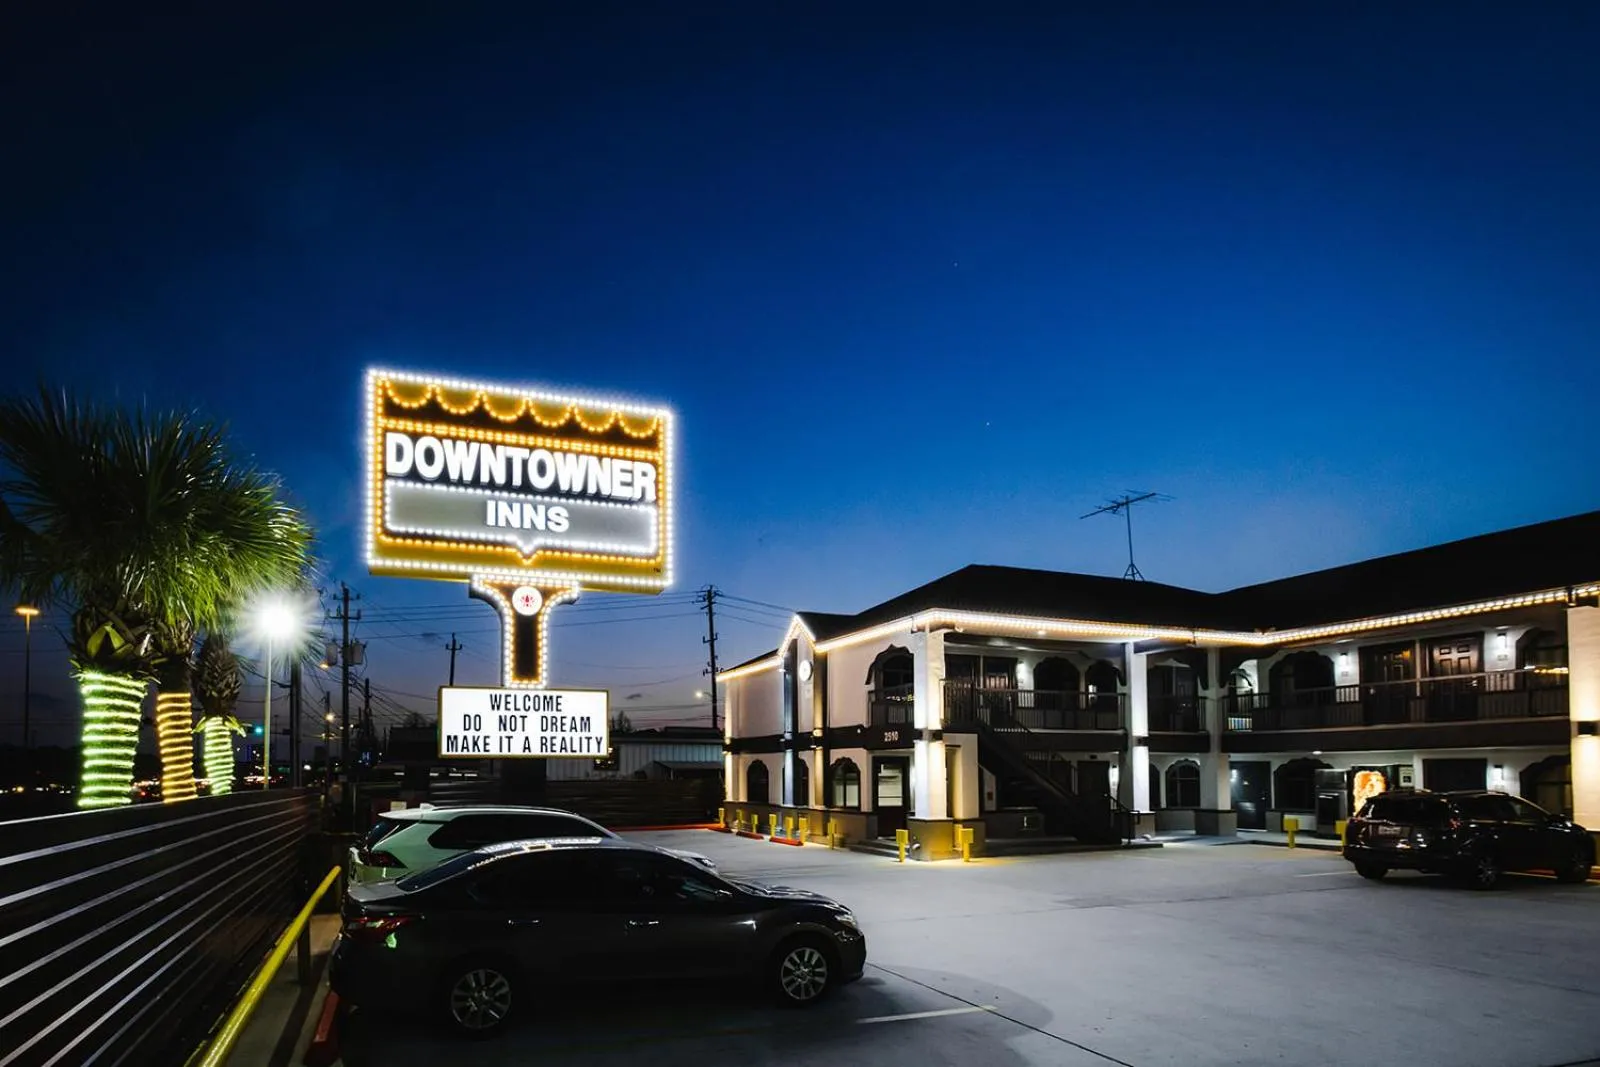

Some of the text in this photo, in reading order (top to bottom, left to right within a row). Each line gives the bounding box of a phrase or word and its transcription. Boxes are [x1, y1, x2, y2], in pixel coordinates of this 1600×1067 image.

[385, 432, 656, 501] DOWNTOWNER
[486, 500, 570, 532] INNS
[490, 693, 563, 712] WELCOME
[463, 714, 591, 733] DO NOT DREAM
[446, 735, 603, 753] MAKE IT A REALITY
